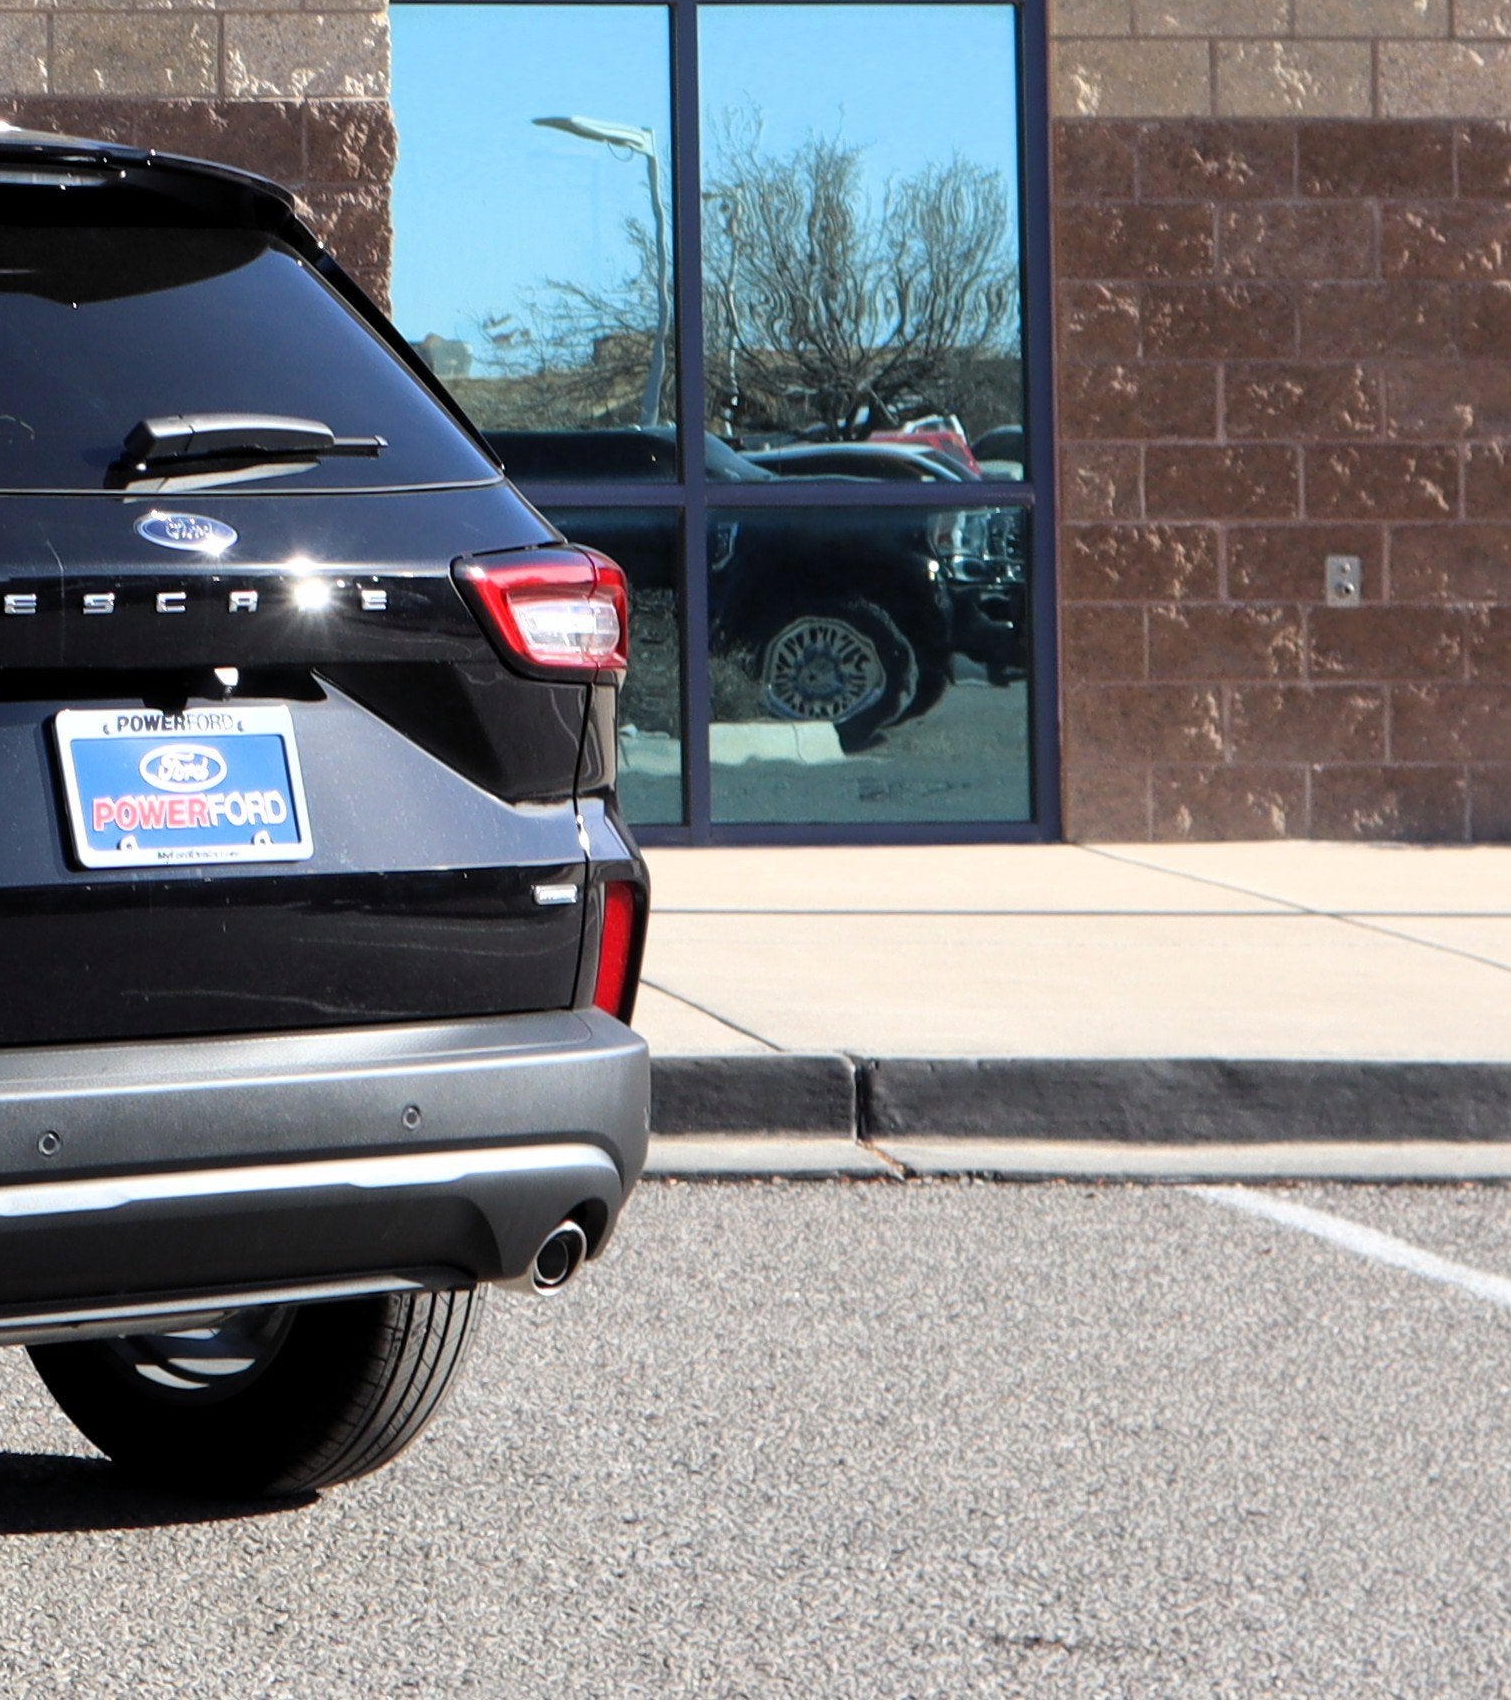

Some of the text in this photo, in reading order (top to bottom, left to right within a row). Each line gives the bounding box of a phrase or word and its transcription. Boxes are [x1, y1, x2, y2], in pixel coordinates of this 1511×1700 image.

[3, 589, 388, 616] ESCAE
[116, 713, 234, 733] POWERFORD
[156, 751, 210, 783] Ford
[91, 789, 288, 832] POWERFORD
